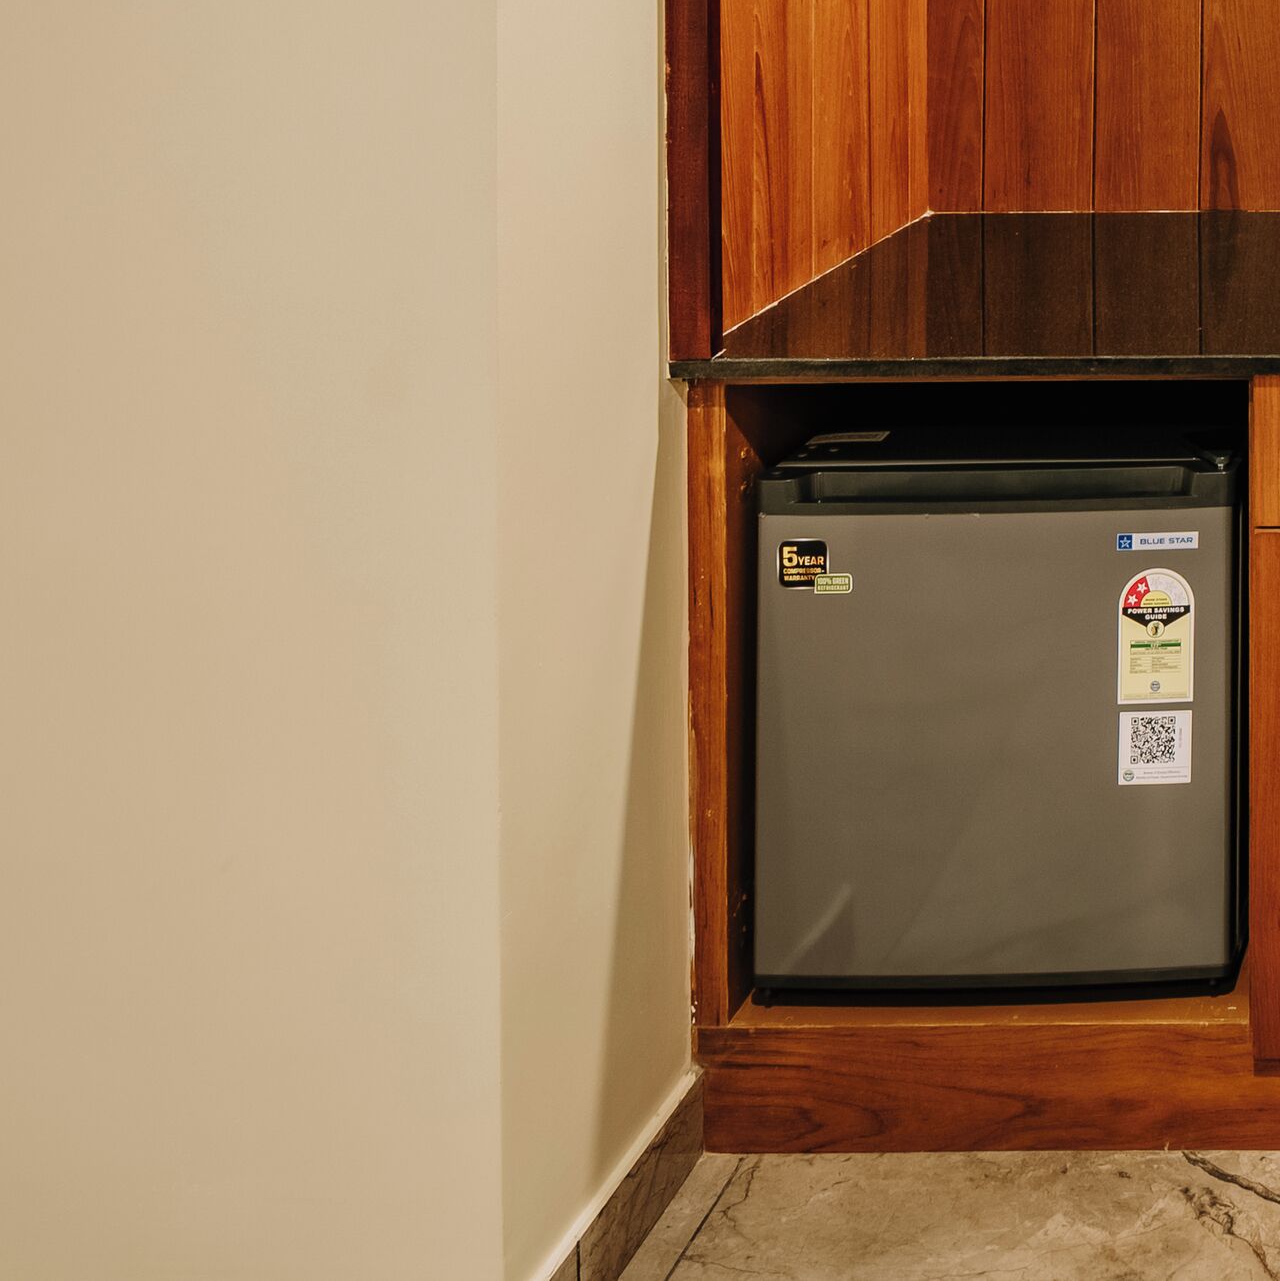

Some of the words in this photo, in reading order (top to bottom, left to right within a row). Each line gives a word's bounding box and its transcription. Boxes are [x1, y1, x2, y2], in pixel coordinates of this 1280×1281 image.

[783, 546, 798, 567] 5
[798, 556, 824, 566] YEAR
[1153, 606, 1185, 614] SAVINGS
